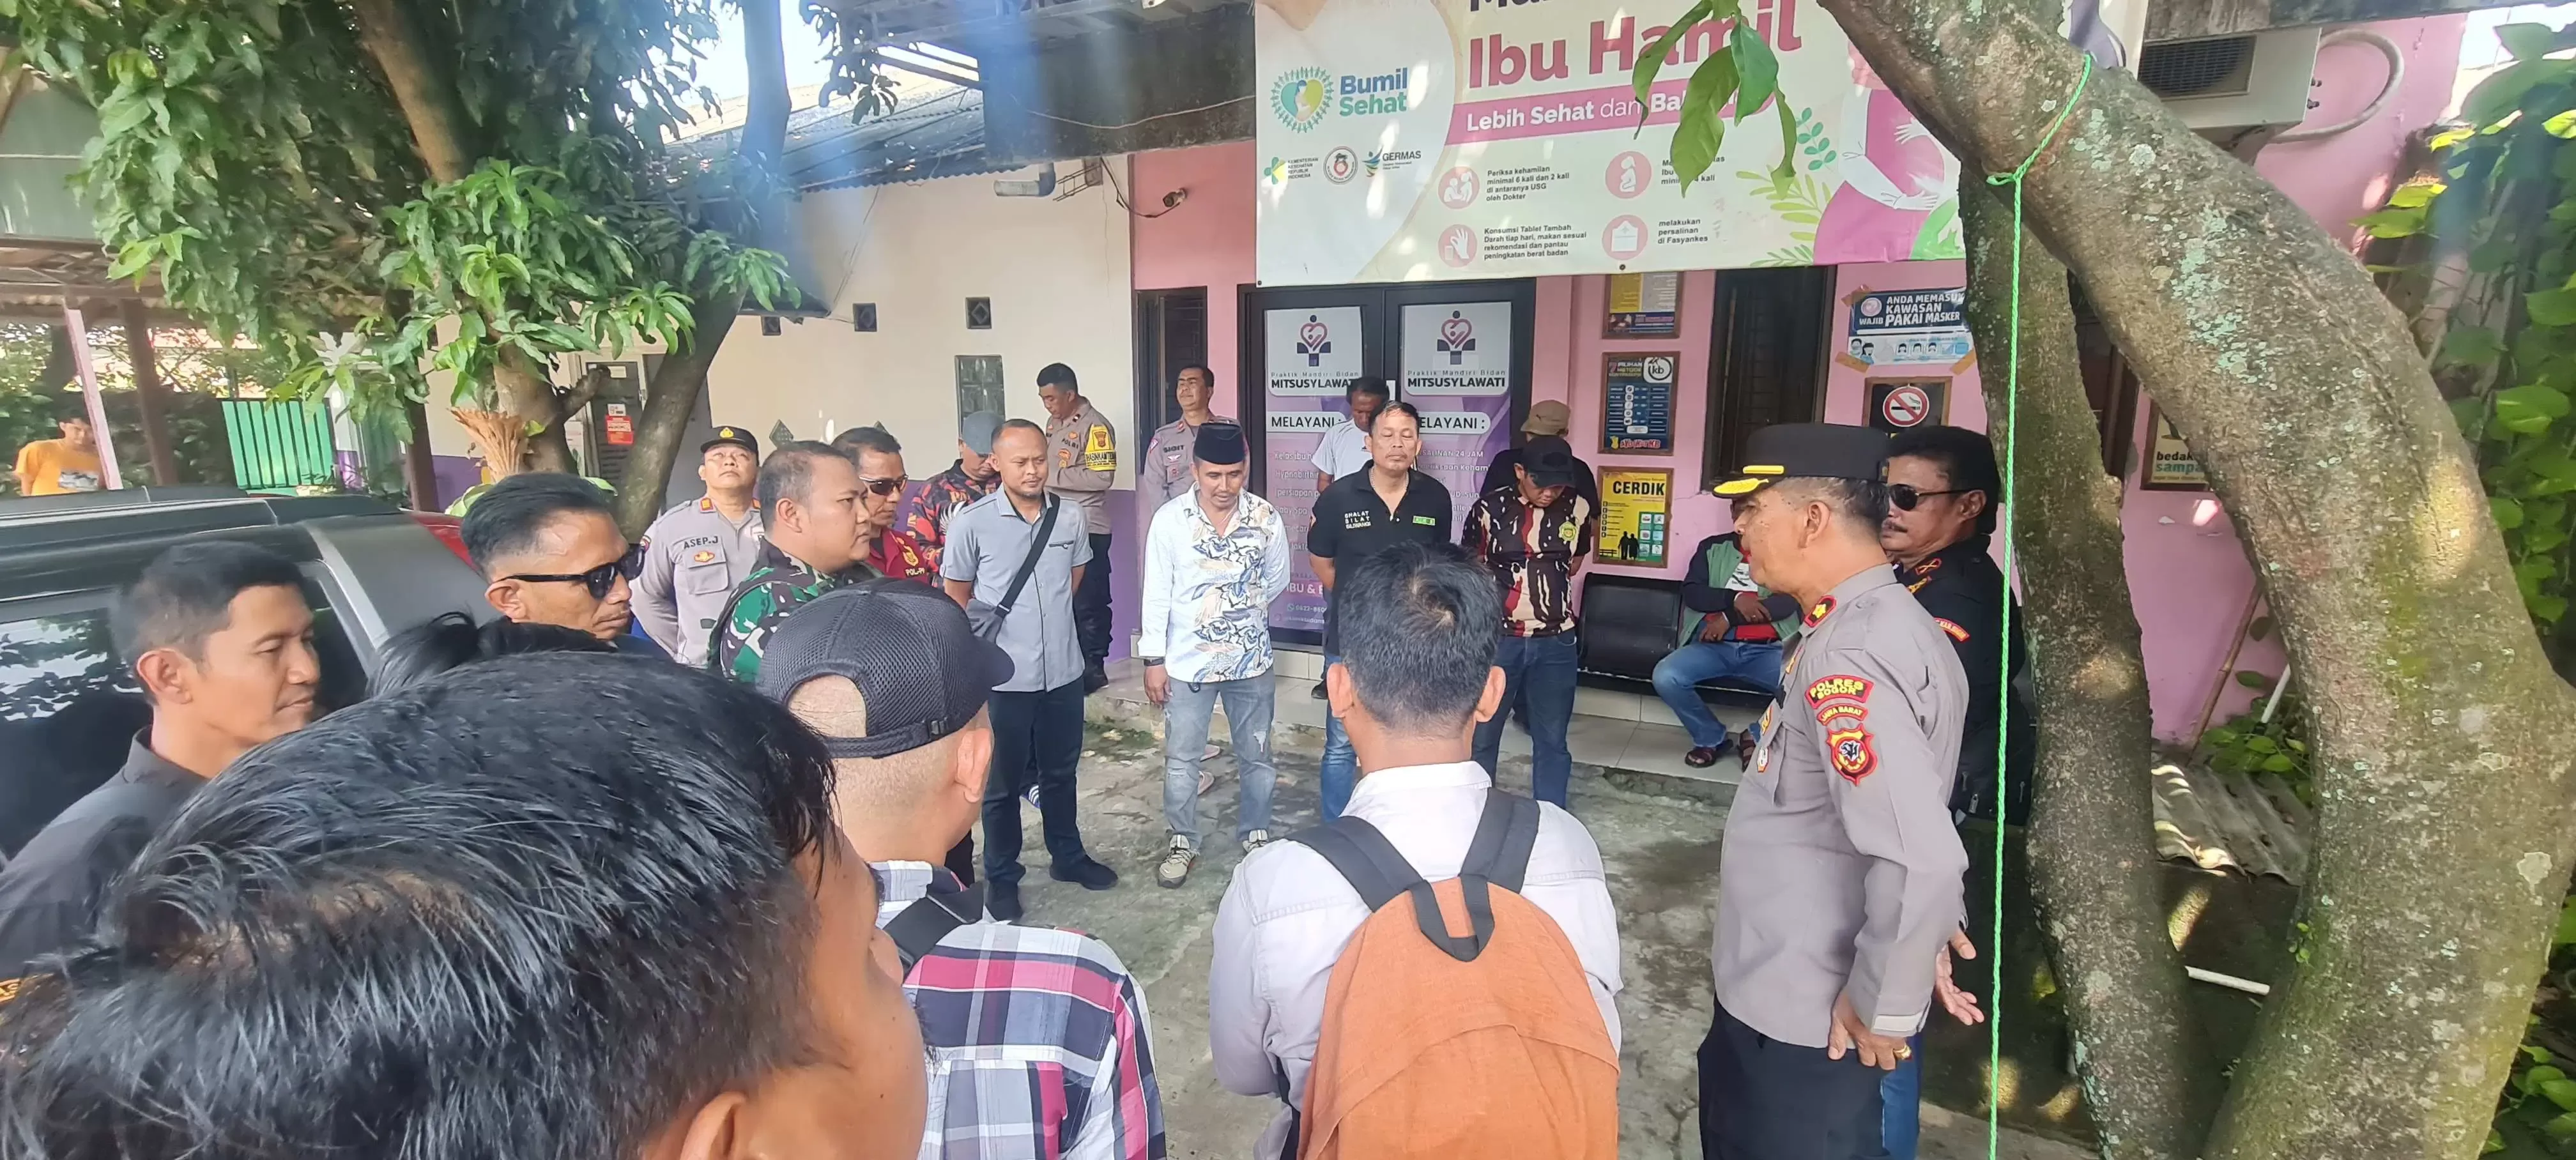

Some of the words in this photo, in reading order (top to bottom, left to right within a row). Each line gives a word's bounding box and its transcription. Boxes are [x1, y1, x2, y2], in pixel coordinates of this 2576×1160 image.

[1469, 34, 1568, 88] Ibu
[1340, 67, 1407, 95] Bumil
[1339, 92, 1407, 116] Sehat
[1467, 108, 1525, 132] Lebih
[1530, 101, 1594, 125] Sehat
[1600, 97, 1641, 118] dan
[1382, 150, 1422, 162] GERMAS
[1515, 166, 1550, 174] kehamilan
[1487, 177, 1514, 185] minimal
[1659, 218, 1701, 227] melakukan
[1658, 227, 1699, 236] persalinan
[1667, 236, 1708, 245] Fasyankes
[1484, 252, 1525, 261] peningkatan
[1887, 295, 1913, 304] ANDA
[1885, 303, 1942, 314] KAWASAN
[1859, 317, 1883, 326] WAJIB
[1885, 312, 1923, 327] PAKAI
[1925, 312, 1960, 323] MASKER
[1271, 379, 1353, 388] MITSUSYLAWA
[1407, 378, 1505, 387] MITSUSYLAWATI
[1271, 416, 1335, 427] MELAYANI
[1419, 416, 1477, 429] ELAYANI
[1613, 480, 1665, 496] CERDIK
[683, 536, 719, 550] ASEP.J
[1307, 584, 1315, 594] &
[1809, 678, 1864, 698] POLRES
[1816, 686, 1857, 700] BOGOR
